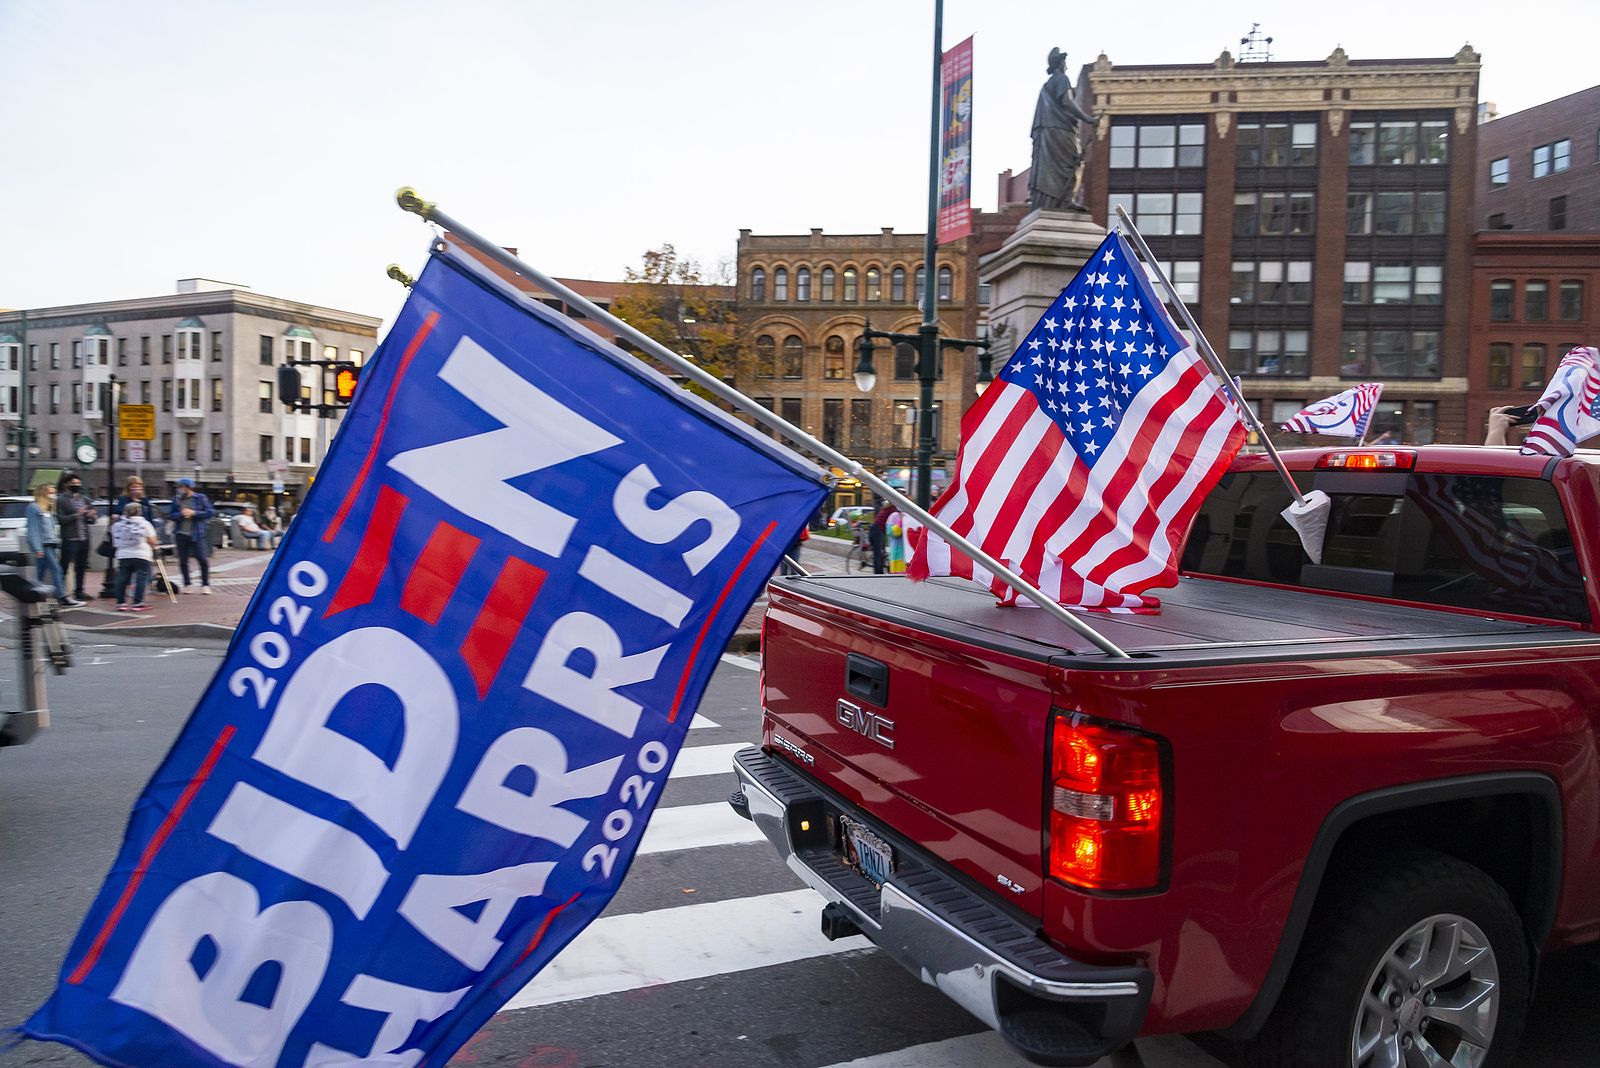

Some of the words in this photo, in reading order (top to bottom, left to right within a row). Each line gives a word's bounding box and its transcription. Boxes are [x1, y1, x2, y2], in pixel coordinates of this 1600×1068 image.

[109, 335, 625, 1068] BIDEN
[228, 560, 329, 710] 2020
[302, 463, 742, 1068] HARRIS
[773, 733, 815, 768] SIERRA
[836, 698, 896, 750] GMC
[581, 740, 669, 879] 2020
[996, 873, 1026, 895] SLT
